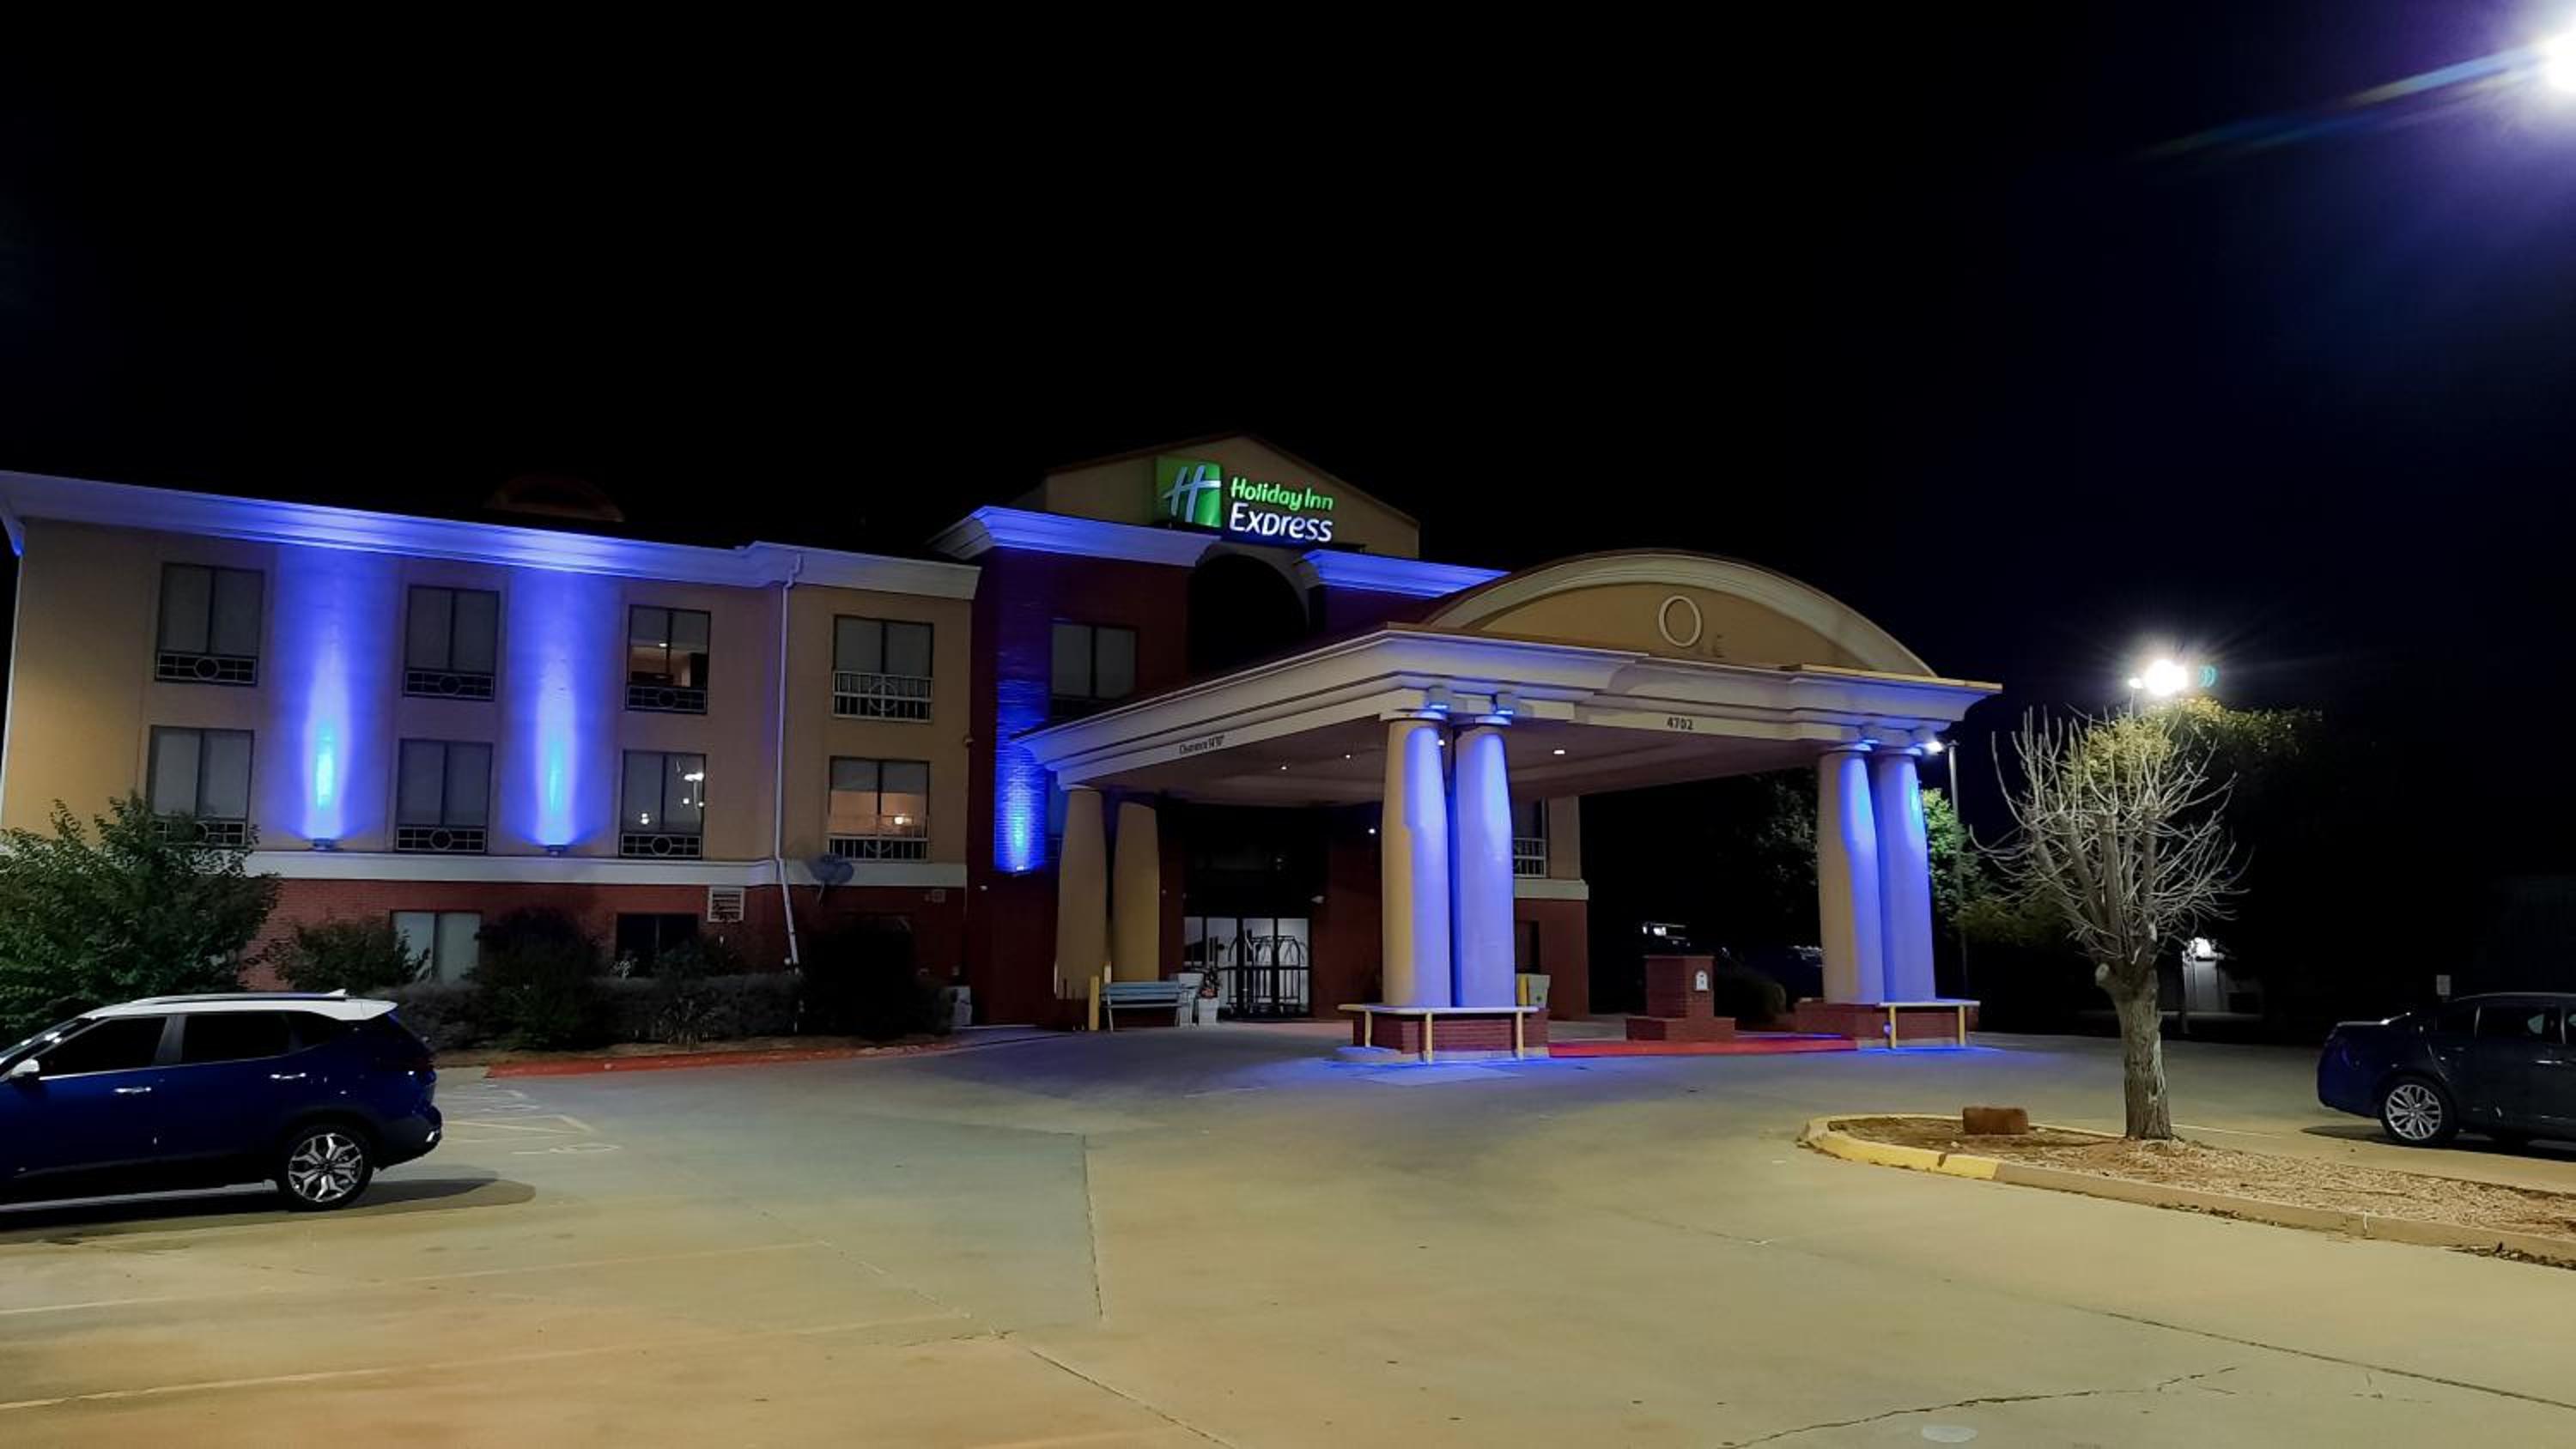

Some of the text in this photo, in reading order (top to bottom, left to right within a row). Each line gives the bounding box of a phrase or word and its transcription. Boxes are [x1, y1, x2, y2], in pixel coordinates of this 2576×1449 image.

[1230, 476, 1334, 511] Holiday Inn
[1229, 502, 1334, 542] Express
